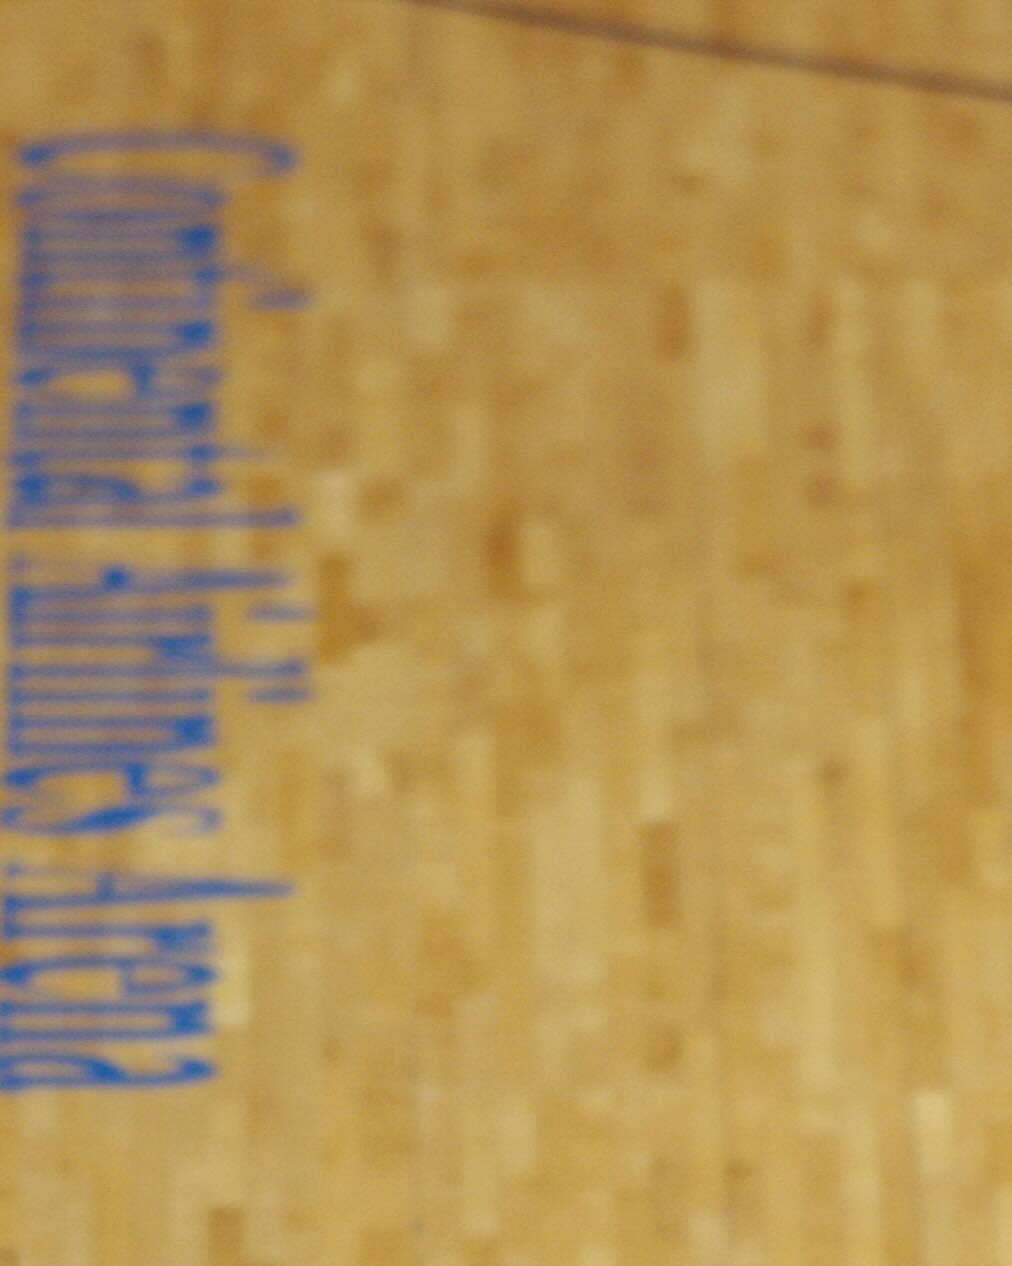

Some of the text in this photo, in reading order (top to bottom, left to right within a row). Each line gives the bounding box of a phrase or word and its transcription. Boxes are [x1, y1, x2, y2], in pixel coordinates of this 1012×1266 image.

[0, 130, 317, 1090] Continental Airlines Arena
